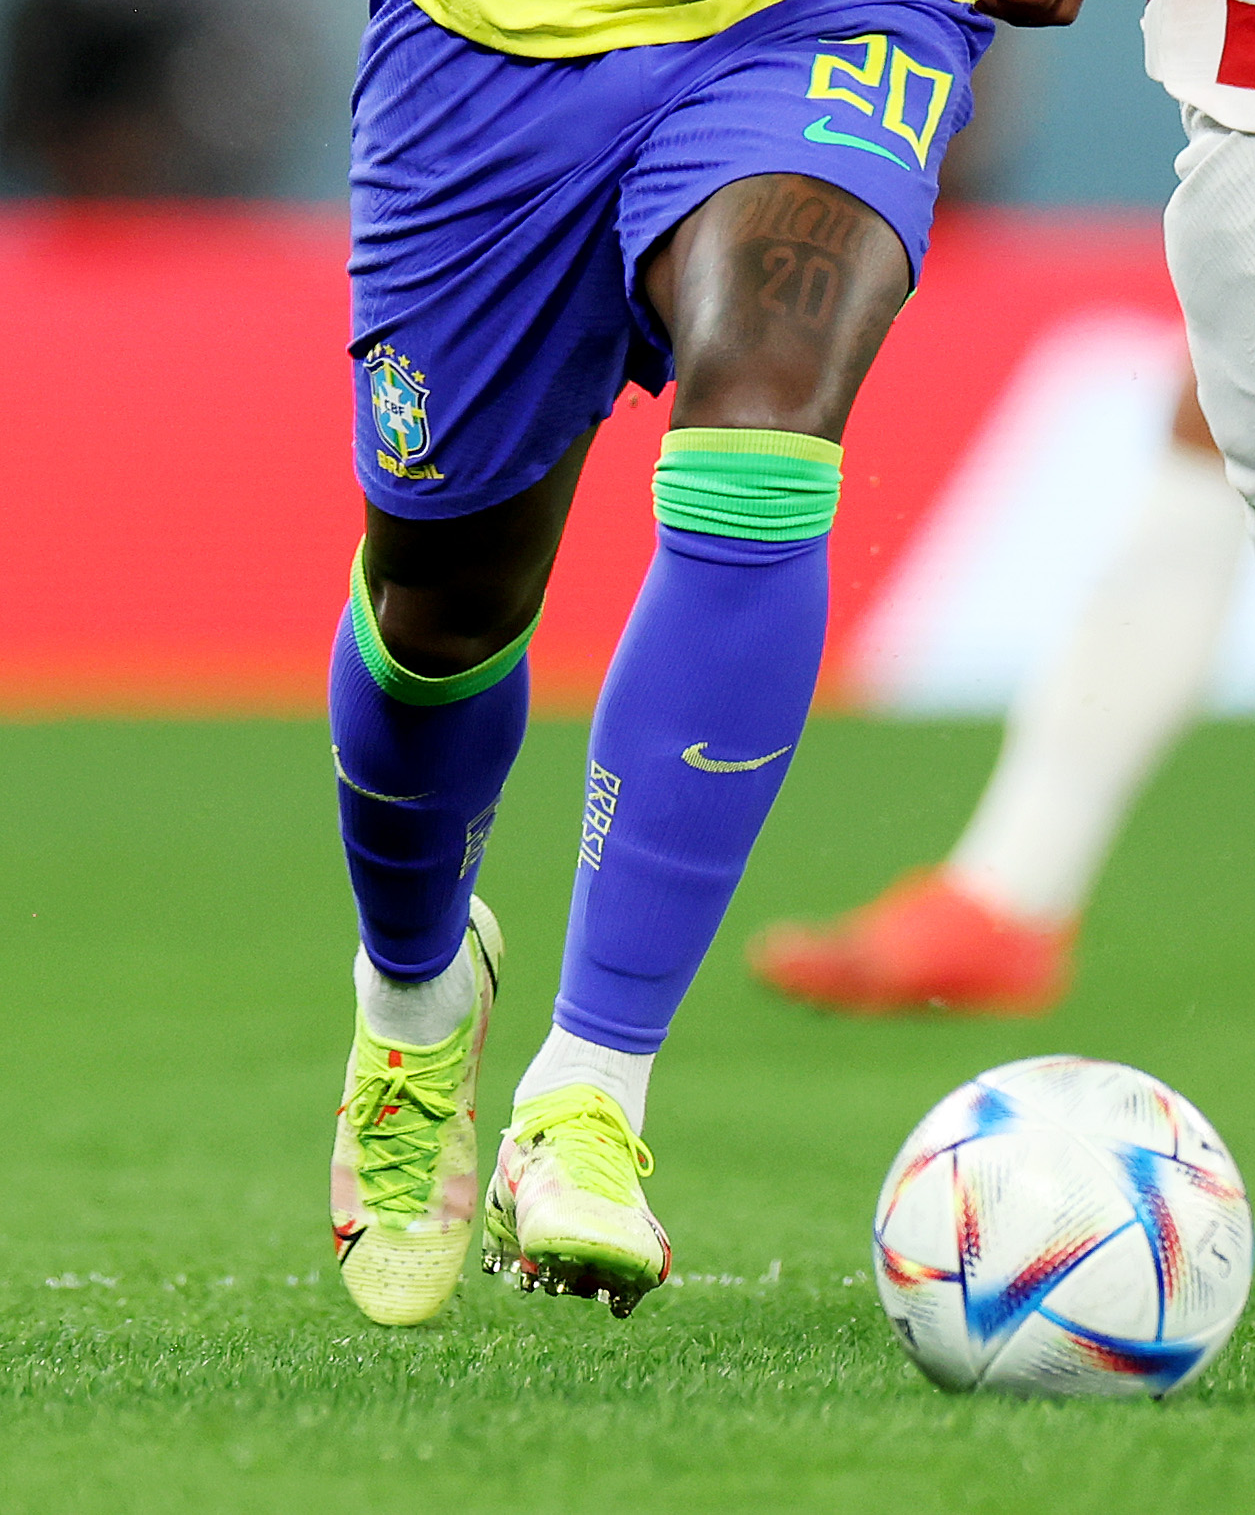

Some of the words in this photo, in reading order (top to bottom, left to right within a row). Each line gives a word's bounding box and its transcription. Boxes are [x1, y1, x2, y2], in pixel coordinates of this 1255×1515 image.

[805, 34, 954, 171] 20
[758, 246, 841, 330] 20
[385, 399, 405, 416] CBF
[577, 760, 621, 871] BRASIL
